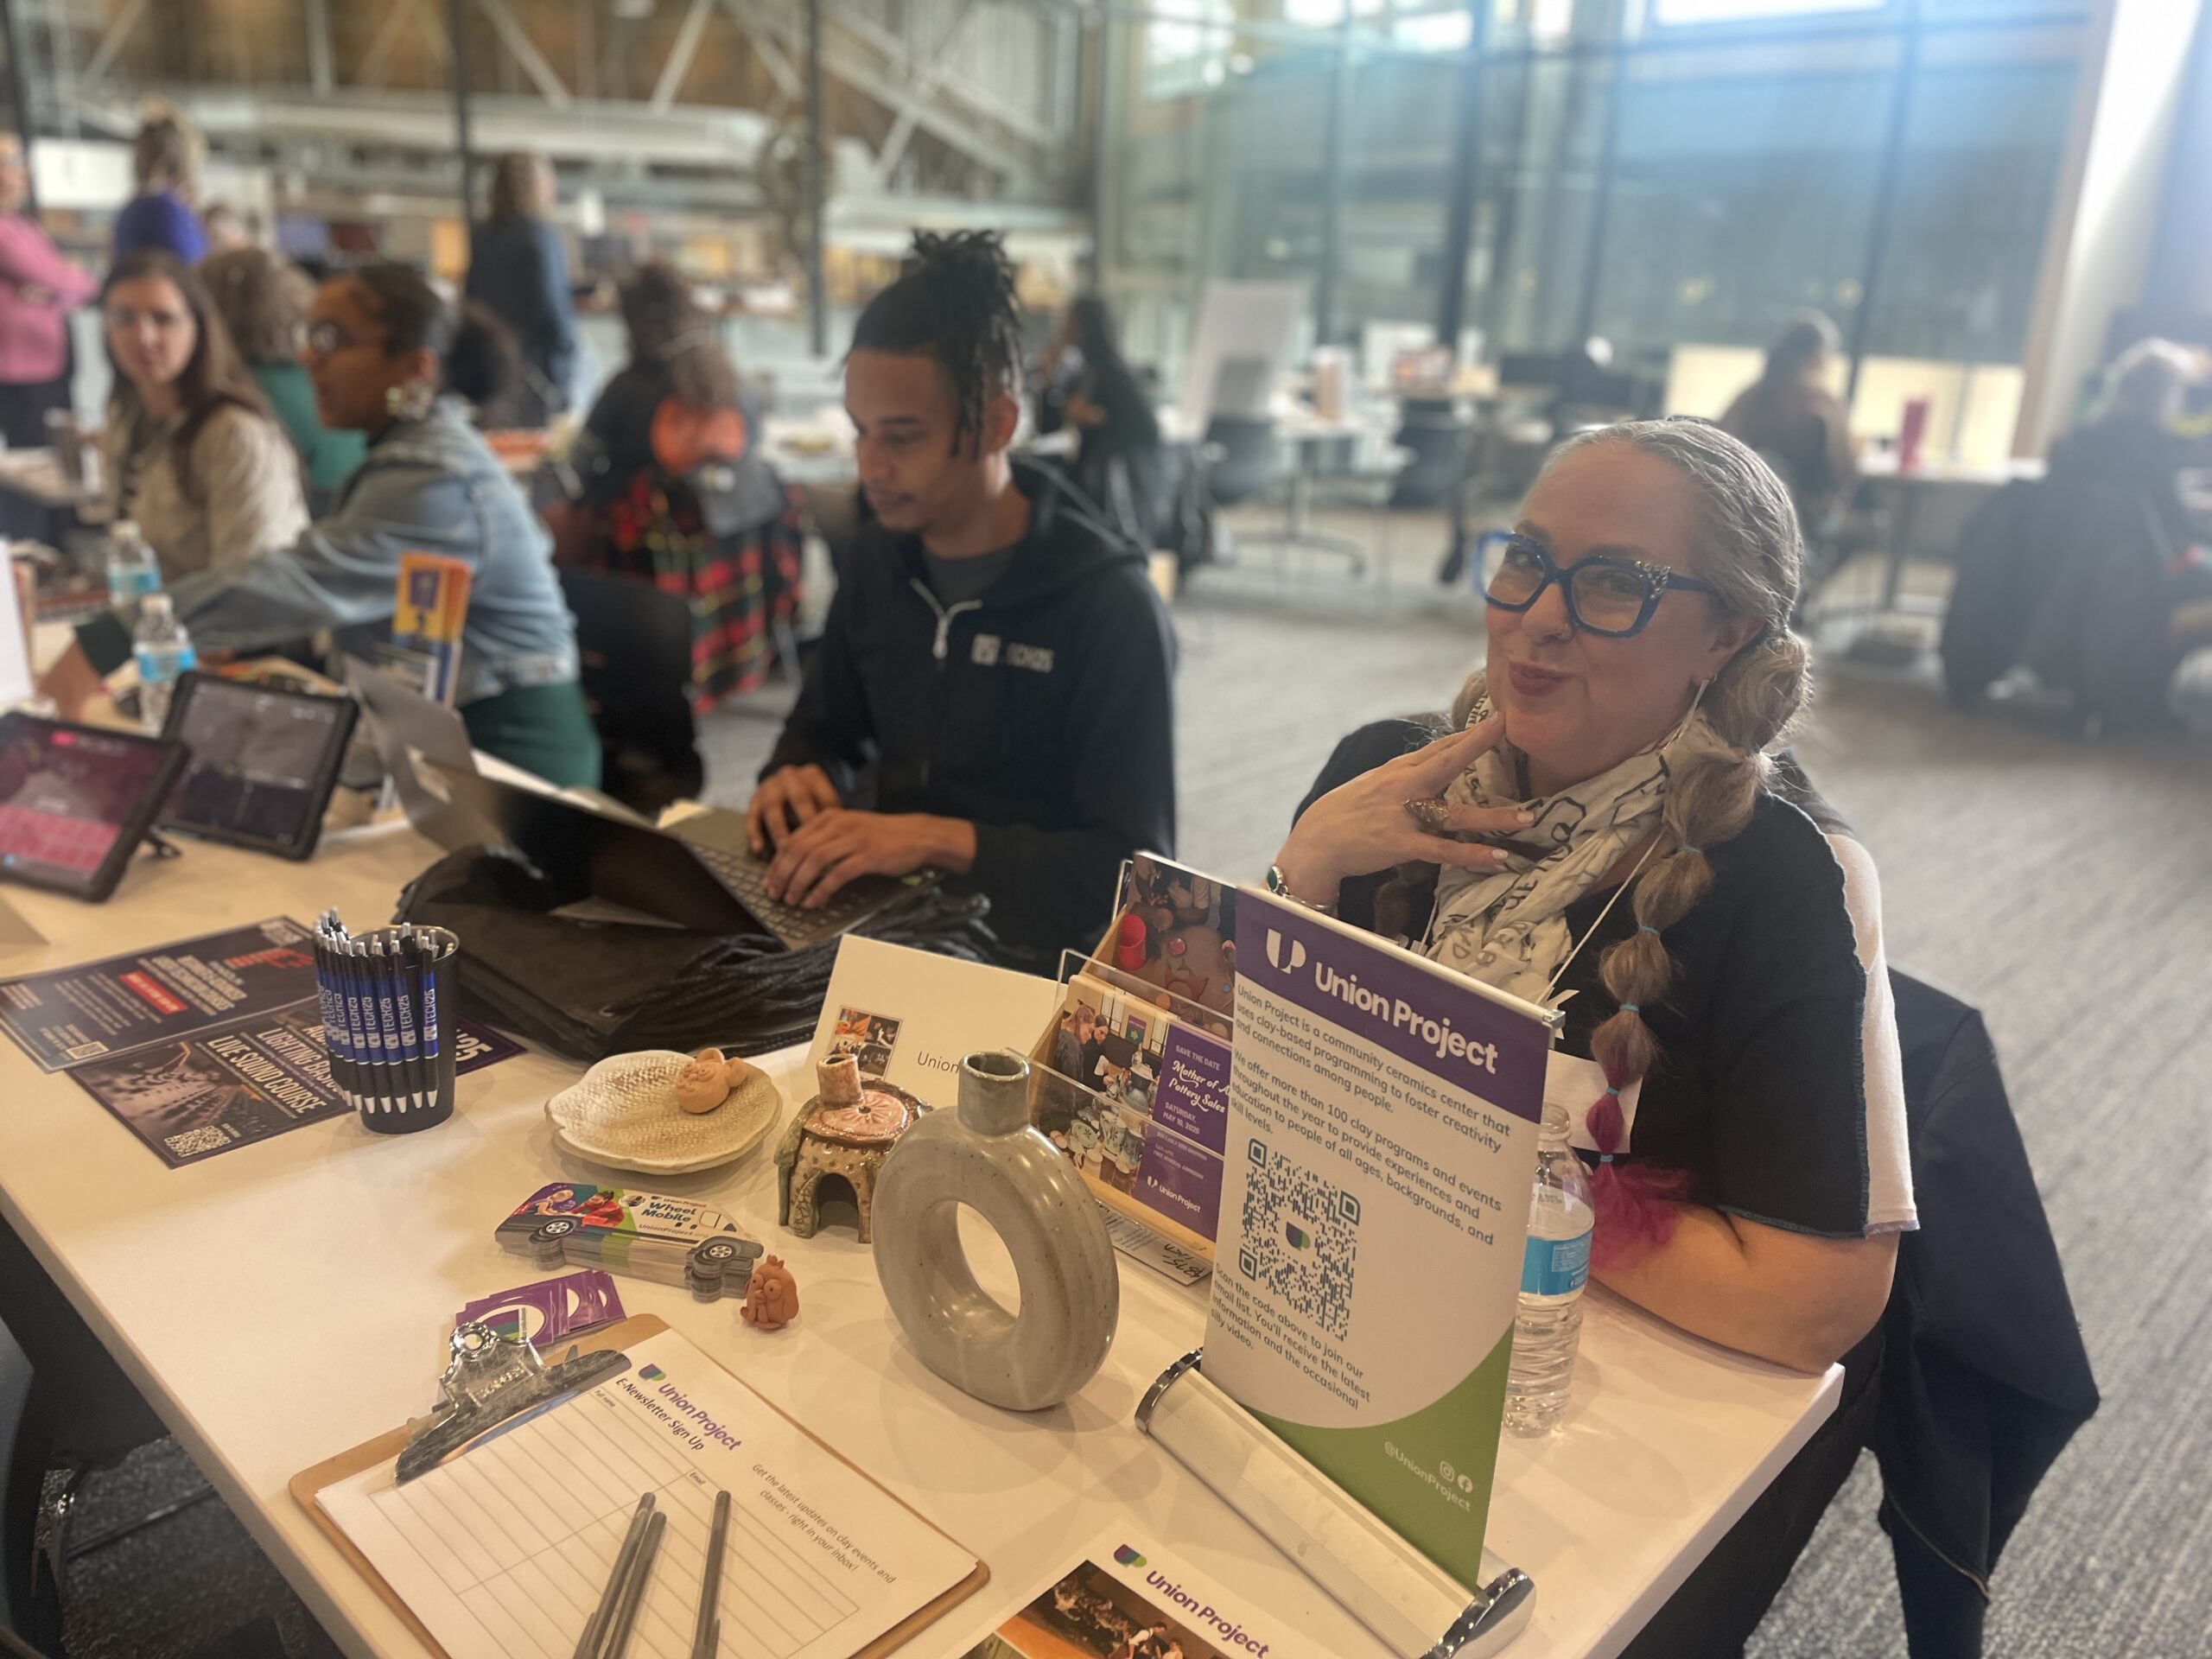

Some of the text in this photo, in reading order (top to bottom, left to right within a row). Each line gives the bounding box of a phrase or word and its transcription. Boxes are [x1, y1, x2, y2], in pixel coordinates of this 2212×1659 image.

[347, 997, 361, 1031] TECH25
[362, 997, 377, 1030] TECH25
[380, 997, 396, 1032] TECH25
[398, 995, 413, 1029] TECH25
[424, 988, 435, 1026] TECH25
[1315, 961, 1498, 1075] Union Project
[207, 1035, 251, 1058] LIVE
[229, 1051, 284, 1084] SOUND
[264, 1077, 327, 1114] COURSE
[257, 1027, 322, 1065] LIGHTING
[917, 1051, 959, 1074] Union
[1172, 1060, 1206, 1088] Mother
[1206, 1080, 1219, 1090] of
[1176, 1045, 1222, 1071] SAVE THE DATE
[1236, 1020, 1394, 1113] and connections among people.
[1236, 1002, 1502, 1154] uses clay-based programming to foster creativity
[1238, 983, 1511, 1137] Union Project is a community ceramics center that
[1163, 1111, 1176, 1122] MAY
[1169, 1077, 1225, 1113] Pottery Sales
[1230, 1097, 1274, 1135] skill levels.
[1232, 1081, 1494, 1246] education to people of all ages, backgrounds, and
[1233, 1064, 1480, 1220] throughout the year to provide experiences and
[1234, 1048, 1503, 1211] We offer more than 100 clay programs and events
[641, 1209, 691, 1222] Mobile
[650, 1202, 697, 1215] Wheel
[1160, 1185, 1201, 1213] Union Project
[1211, 1308, 1254, 1350] silly video.
[1212, 1293, 1359, 1410] information and the occasional
[1214, 1280, 1370, 1403] email list. You'll receive the latest
[1216, 1263, 1363, 1379] Scan the code above to join our
[616, 1377, 704, 1451] E-Newsletter Sign Up
[658, 1383, 741, 1451] Union Project
[1384, 1441, 1471, 1512] @UnionProject
[753, 1464, 897, 1584] Get the latest updates on clay events and
[760, 1490, 786, 1512] classes
[788, 1513, 809, 1531] right
[805, 1528, 816, 1538] in
[812, 1535, 834, 1552] your
[832, 1550, 859, 1572] inbox!
[1146, 1571, 1269, 1659] Union Project
